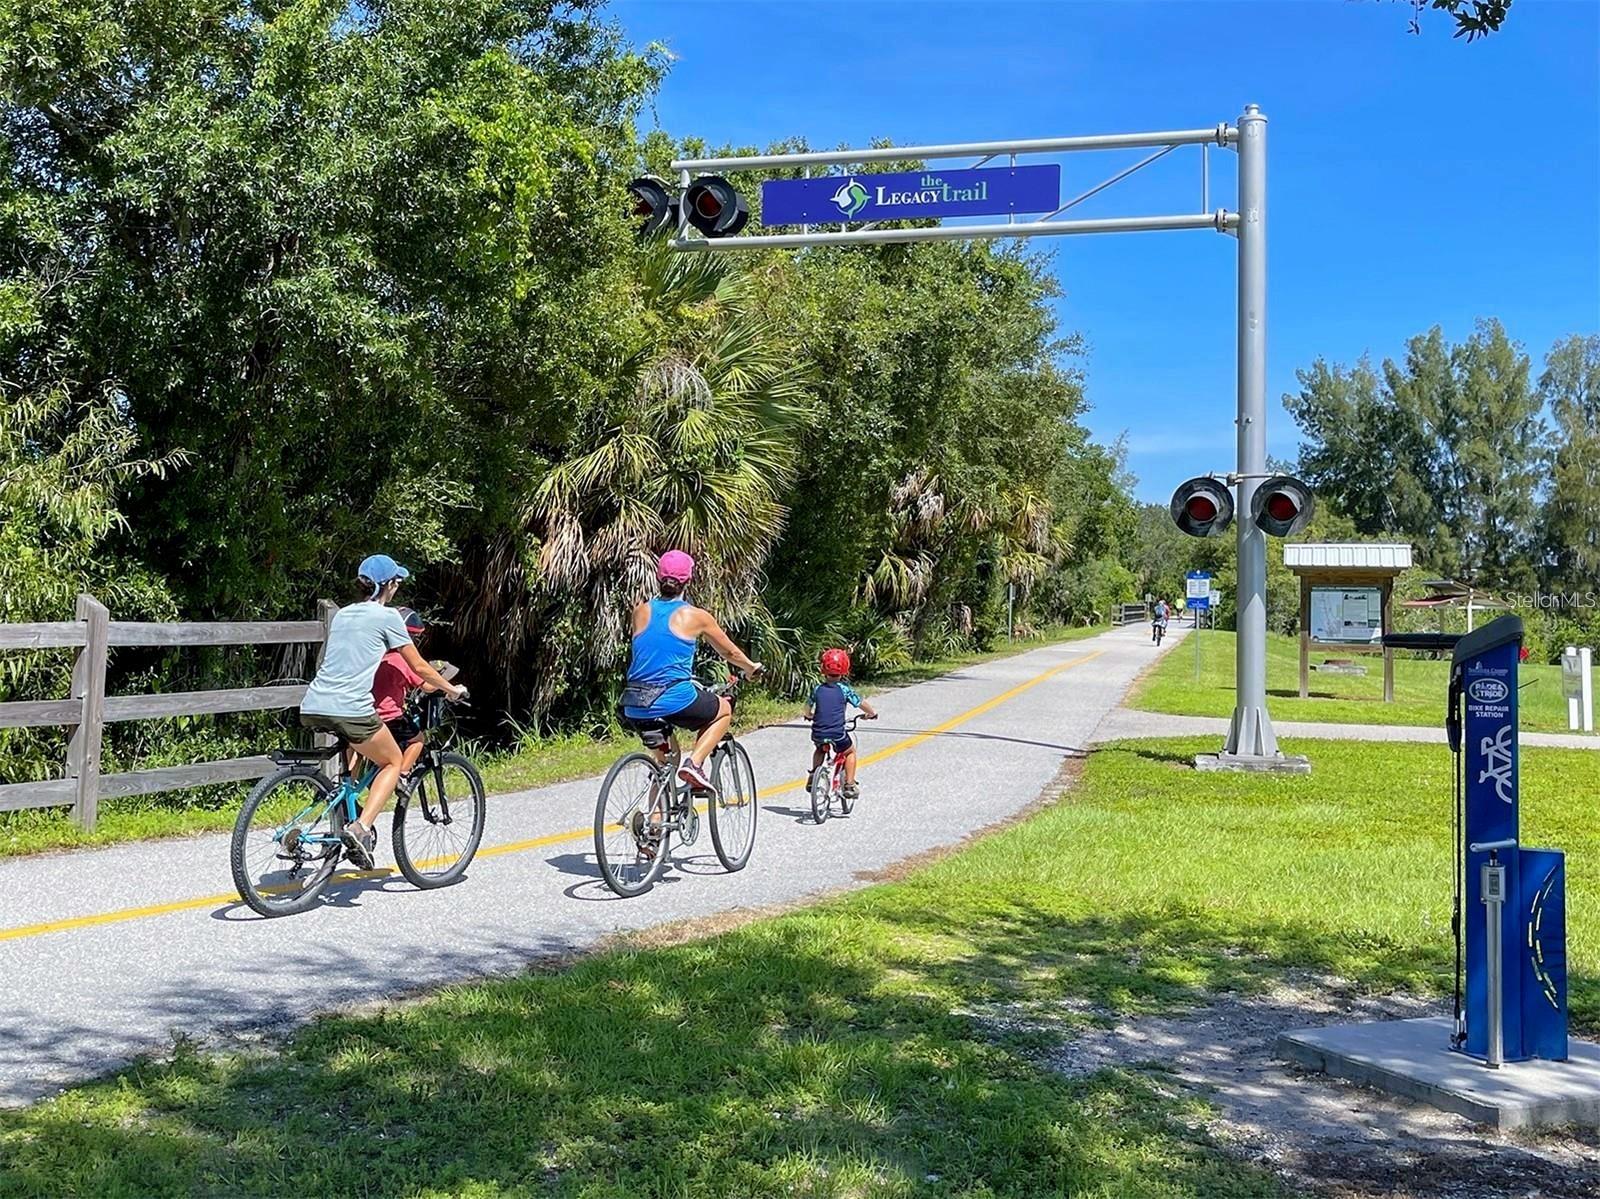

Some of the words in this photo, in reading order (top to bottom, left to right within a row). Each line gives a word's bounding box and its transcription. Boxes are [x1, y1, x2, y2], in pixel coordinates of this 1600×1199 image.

[921, 175, 942, 187] the
[875, 186, 941, 206] LEGACY
[942, 181, 988, 202] trail
